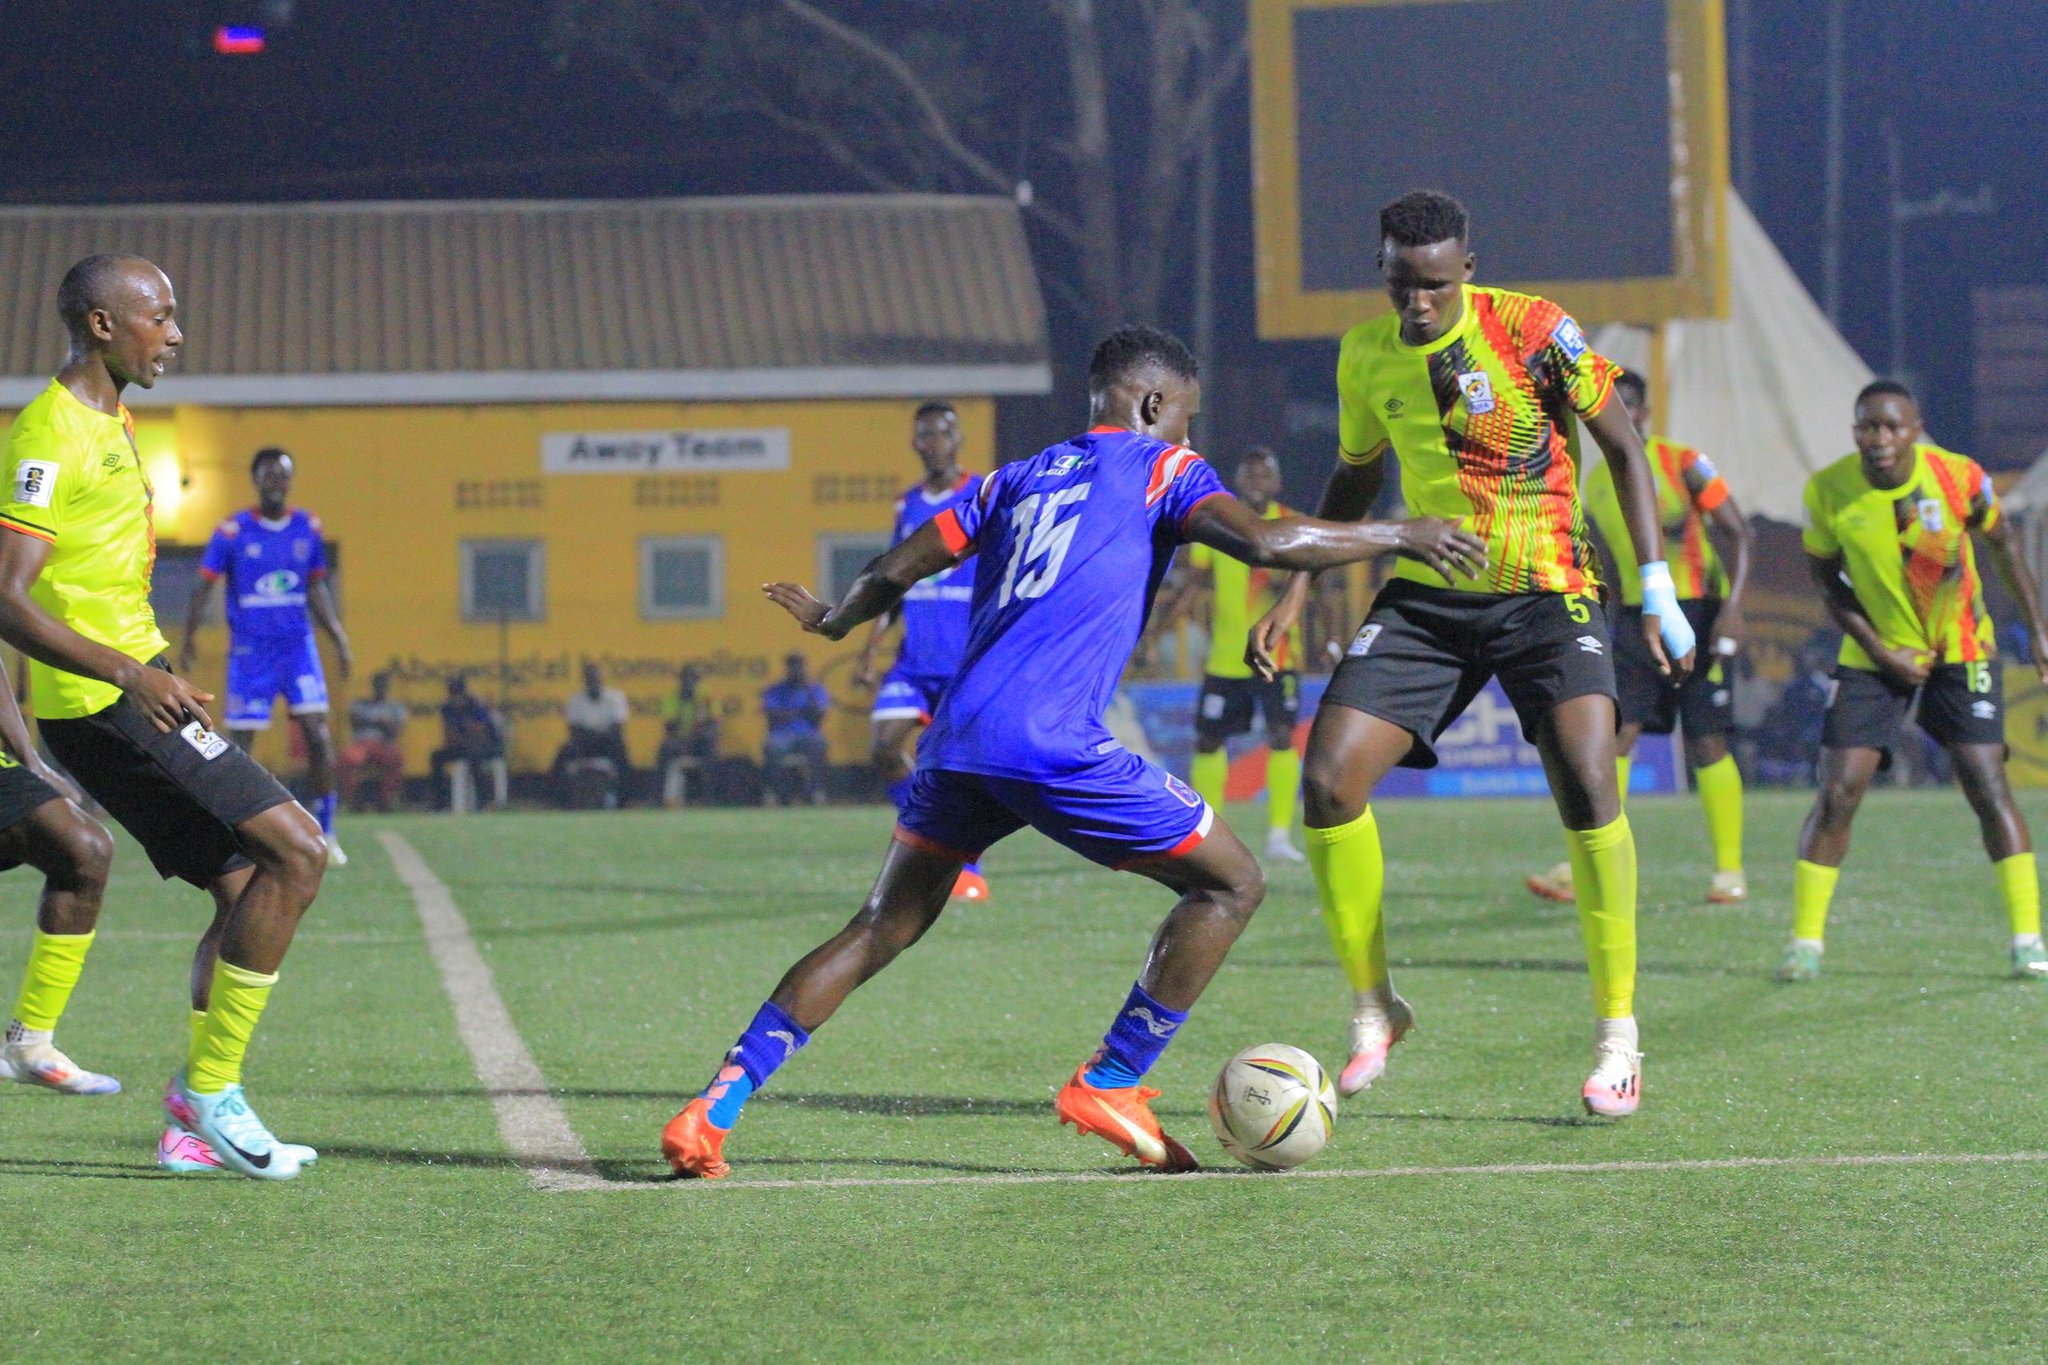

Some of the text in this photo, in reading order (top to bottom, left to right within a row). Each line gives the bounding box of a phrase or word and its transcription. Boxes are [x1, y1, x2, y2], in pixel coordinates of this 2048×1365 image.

[567, 431, 767, 466] Away Team
[998, 481, 1092, 609] 15
[1563, 593, 1591, 624] 5
[1965, 661, 1993, 694] 15
